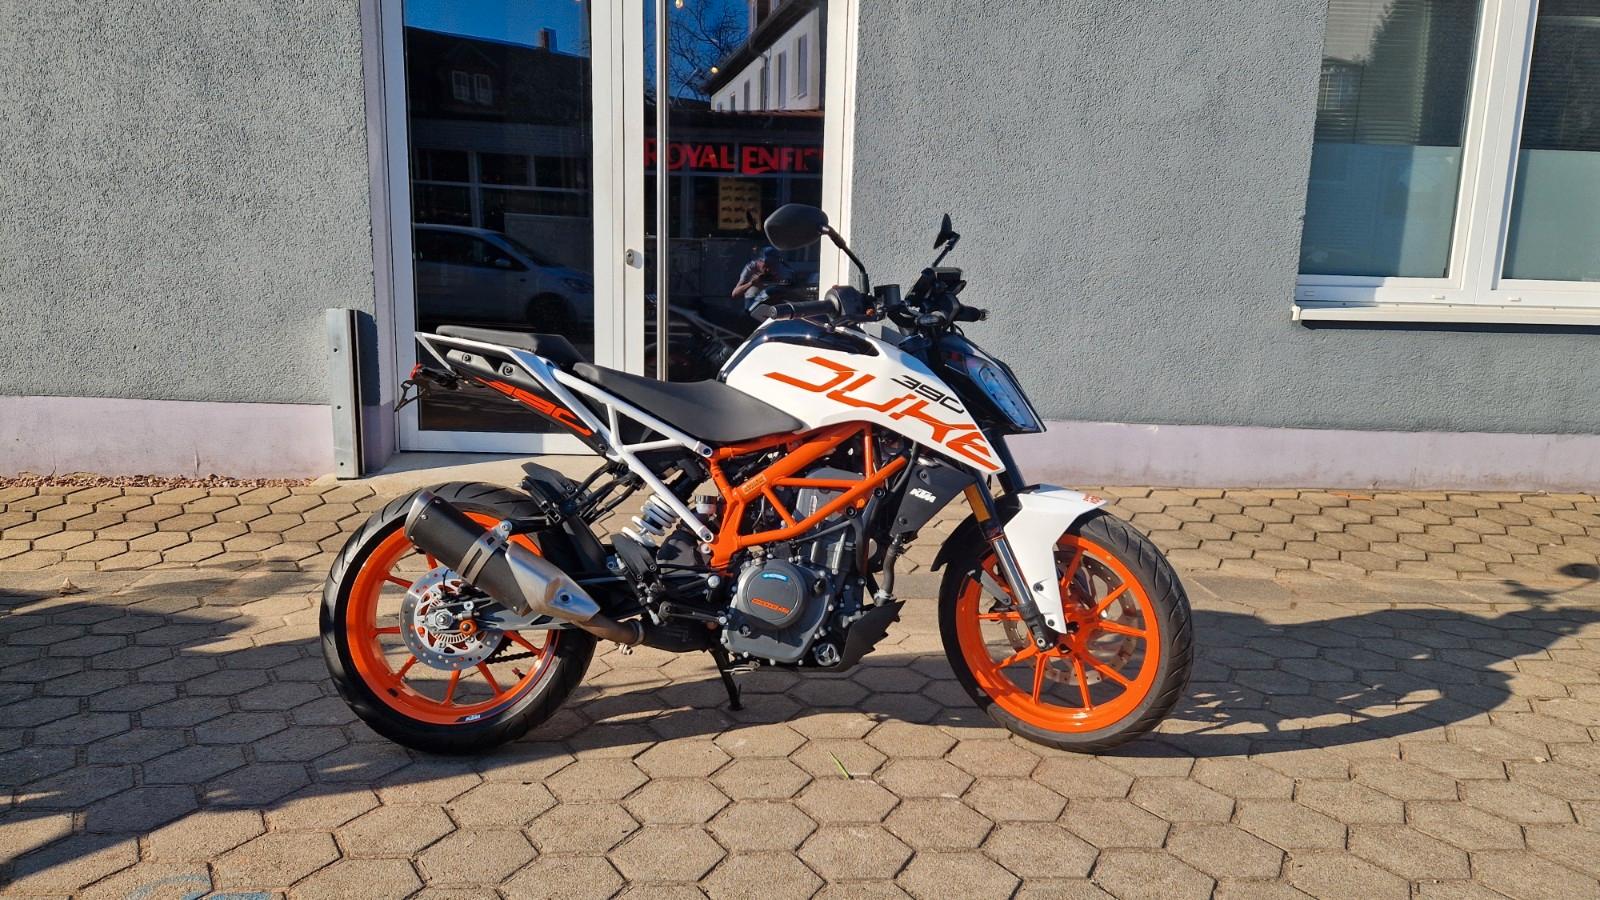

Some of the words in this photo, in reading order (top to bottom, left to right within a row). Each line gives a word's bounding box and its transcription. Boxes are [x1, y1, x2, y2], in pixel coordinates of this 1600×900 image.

[763, 356, 1000, 472] DUKE
[890, 375, 965, 414] 390
[909, 487, 937, 504] KTM
